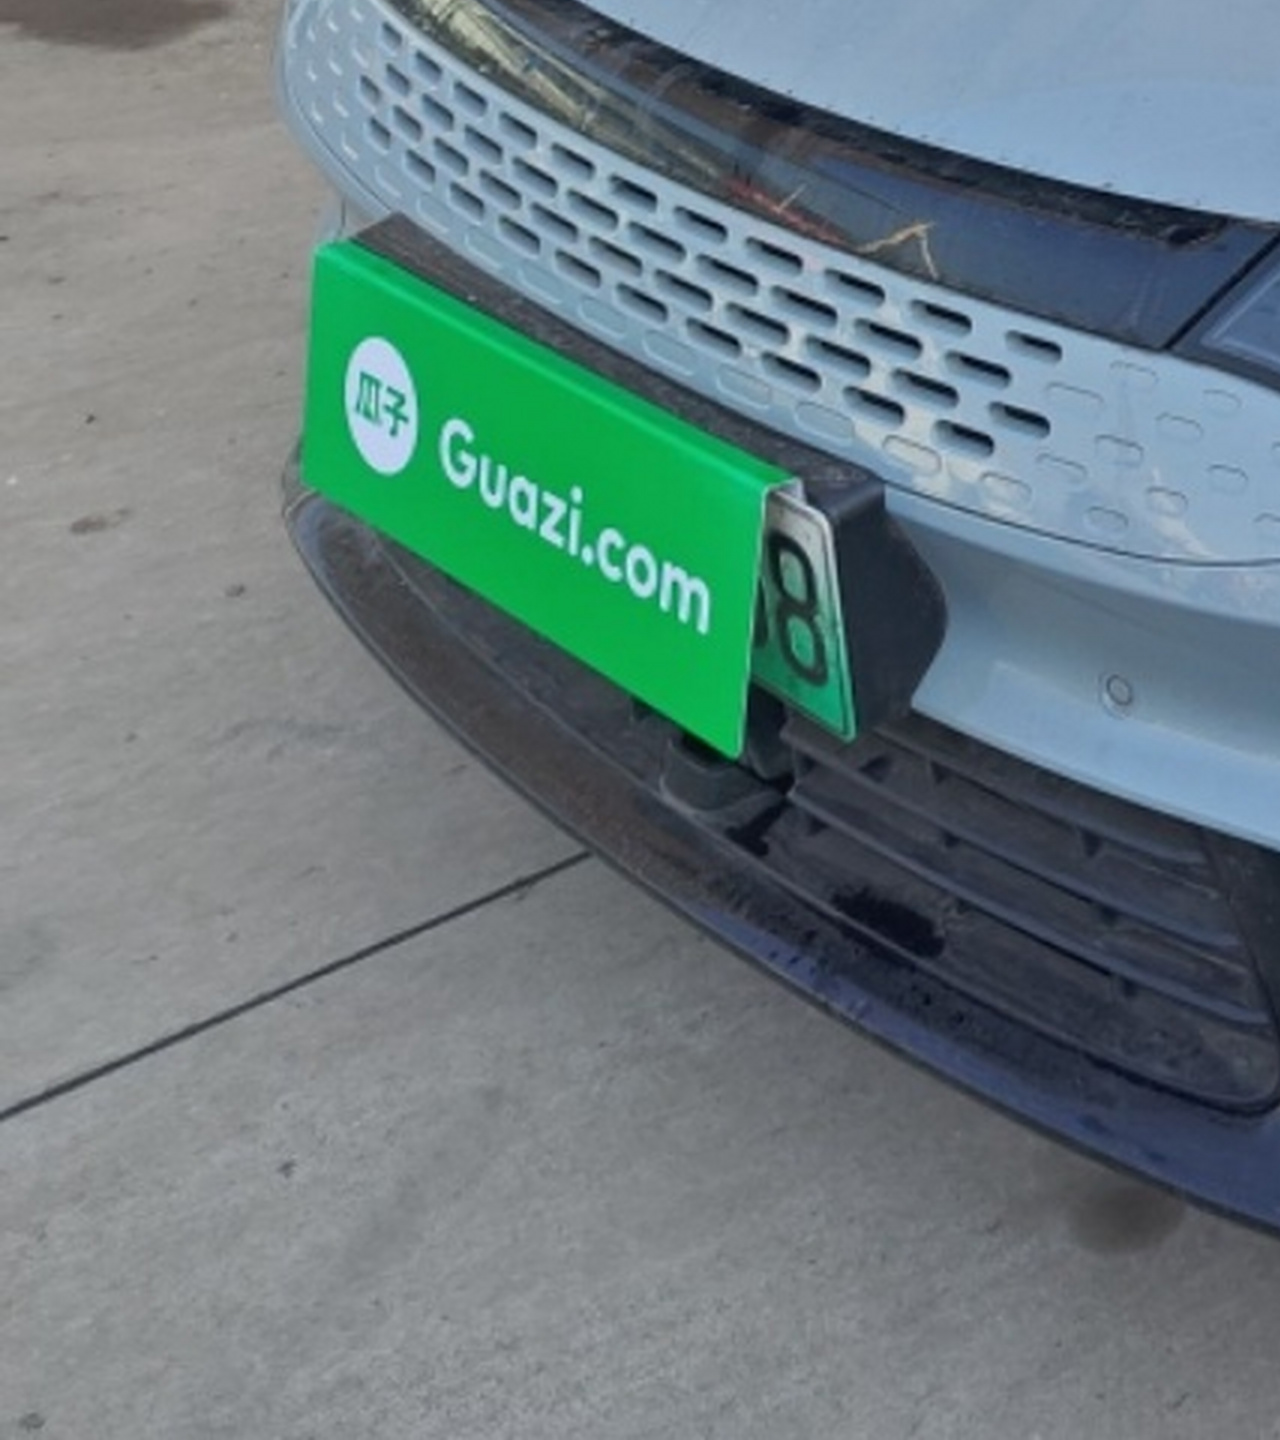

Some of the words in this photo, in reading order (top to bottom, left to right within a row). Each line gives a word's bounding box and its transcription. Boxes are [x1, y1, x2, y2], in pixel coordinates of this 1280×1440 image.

[355, 370, 410, 437] 瓜子
[438, 417, 711, 636] Guazi.com
[753, 526, 830, 688] 8
